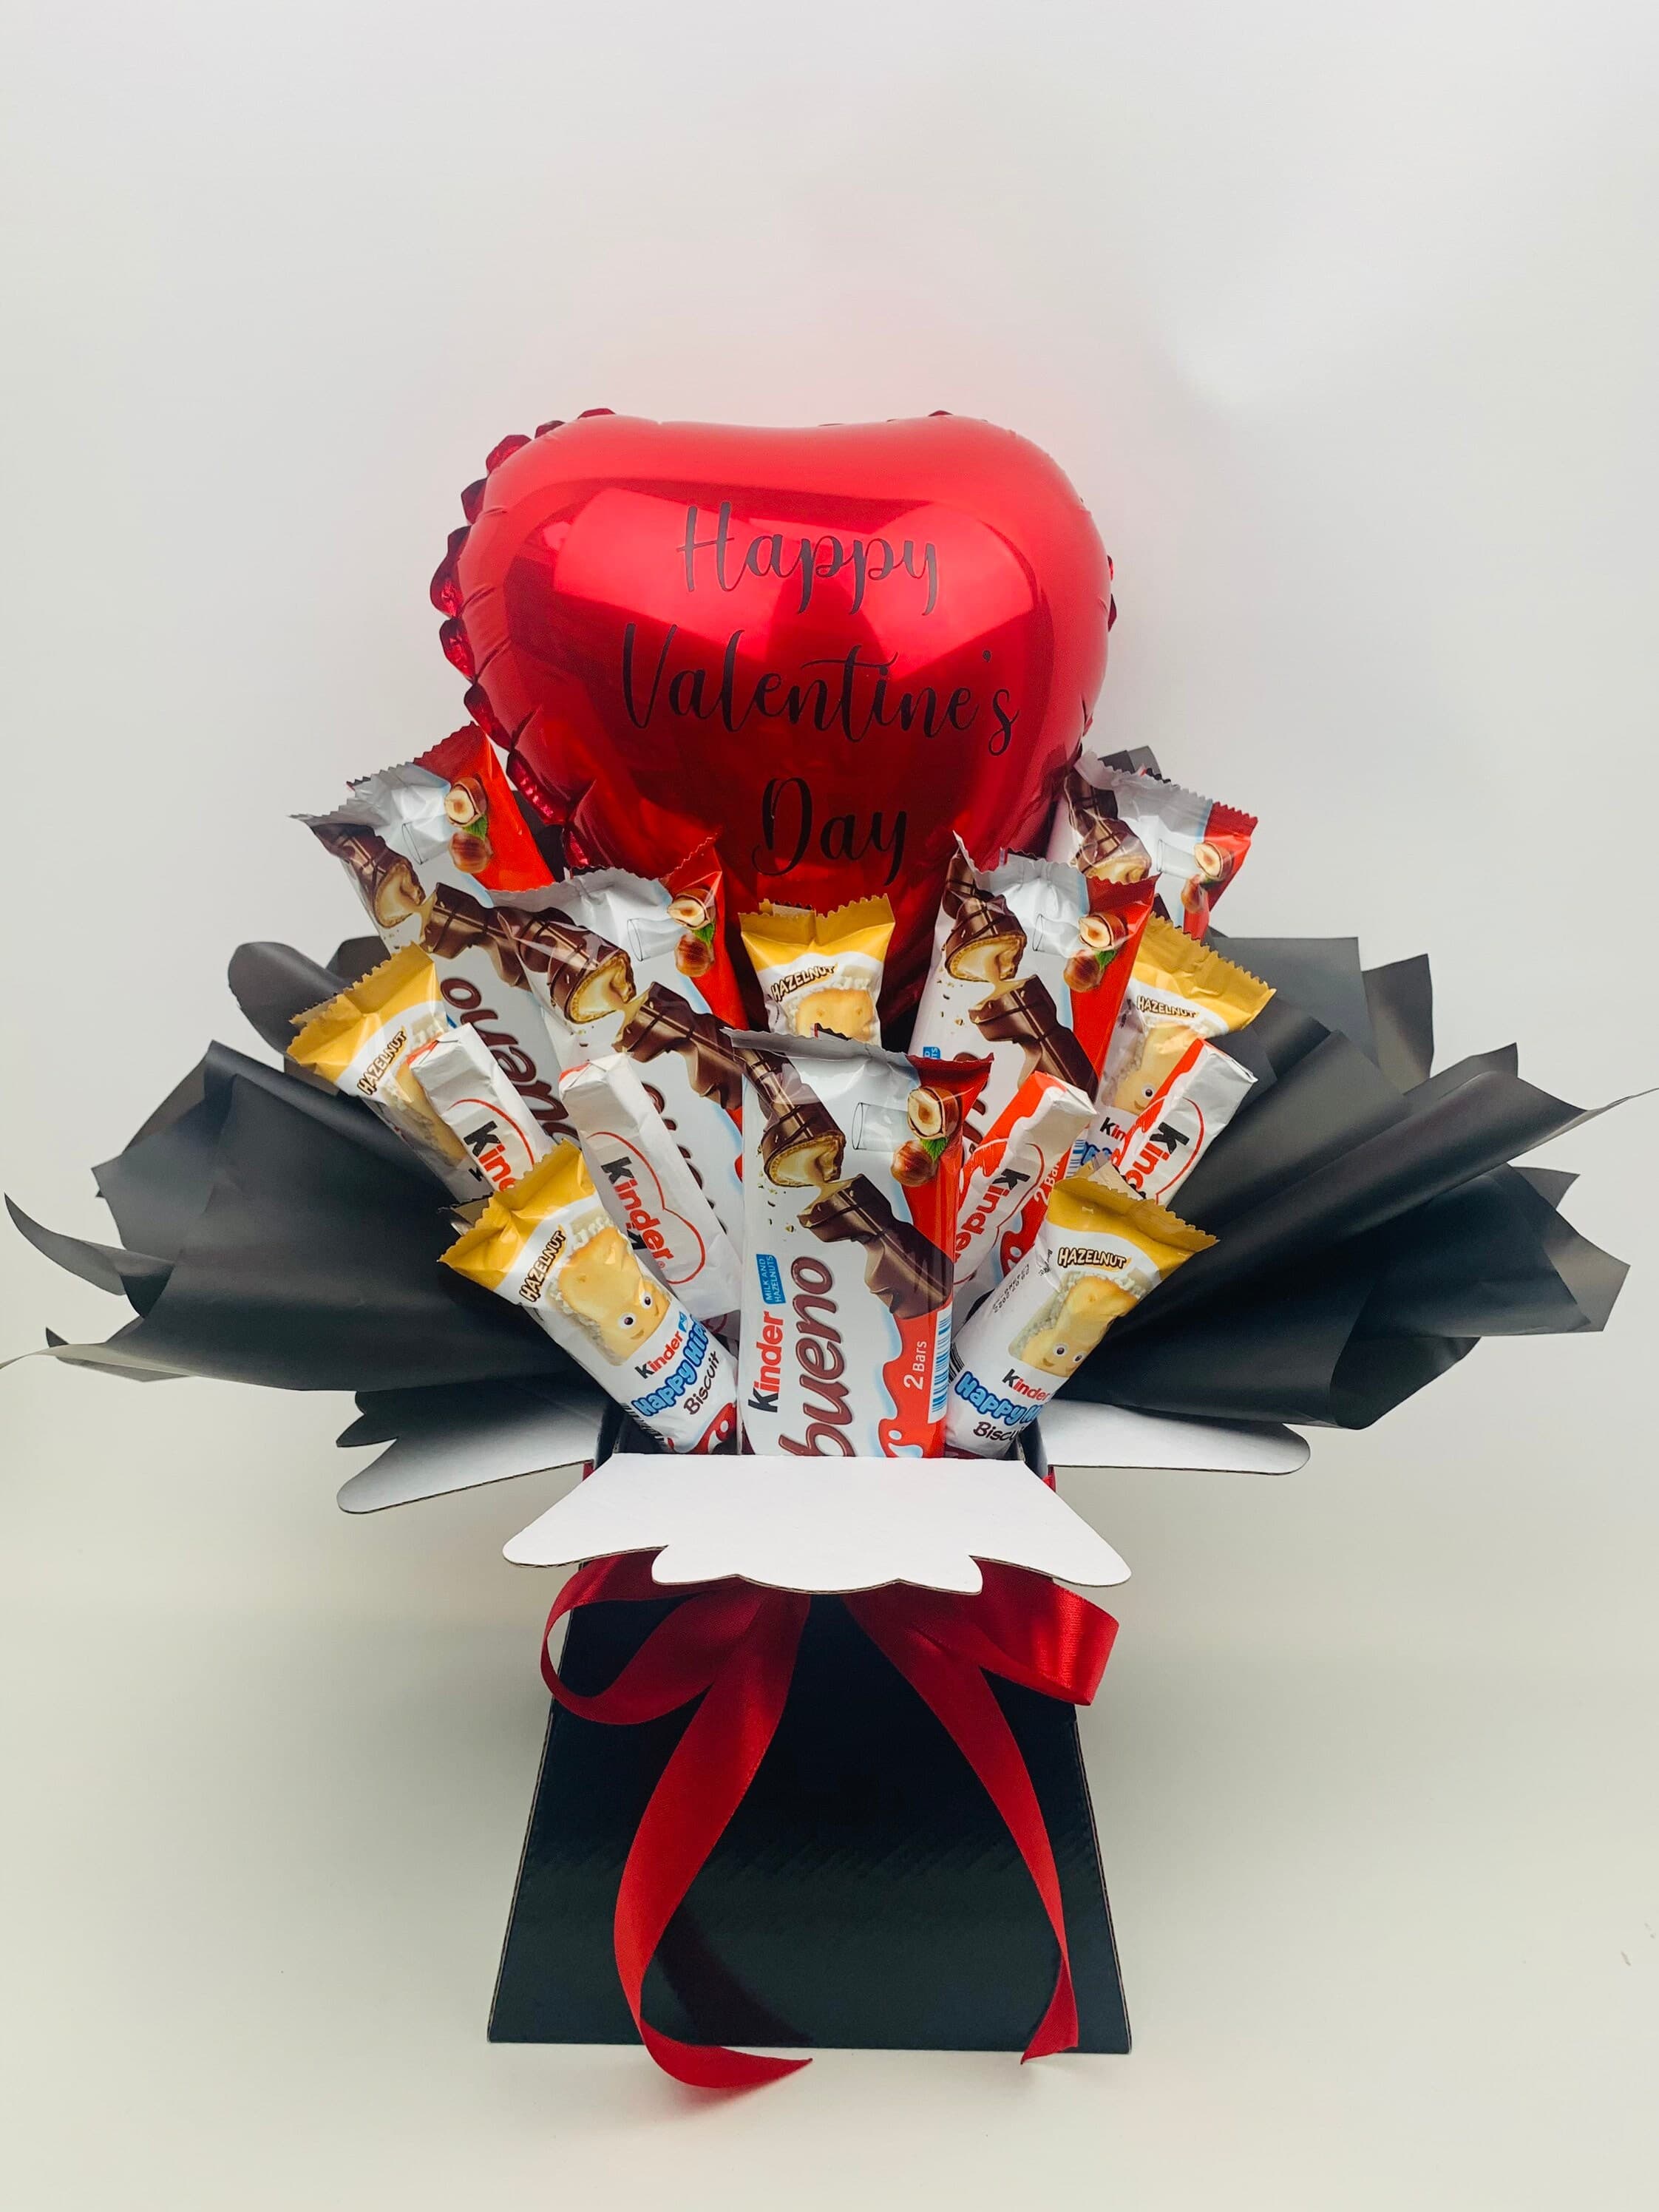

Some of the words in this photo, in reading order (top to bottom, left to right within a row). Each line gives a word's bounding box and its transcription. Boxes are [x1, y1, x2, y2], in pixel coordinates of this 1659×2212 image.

[676, 501, 937, 616] Happy
[622, 622, 1020, 756] Valentine's
[750, 777, 907, 886] Day
[770, 965, 836, 1002] HAZELNUT
[1136, 995, 1196, 1017] HAZELNUT
[356, 1028, 407, 1095] HAZELNUT
[600, 1156, 674, 1263] Kinder
[519, 1229, 567, 1303] HAZELNUT
[759, 1258, 767, 1278] AND
[763, 1280, 773, 1300] MILK
[767, 1255, 782, 1302] HAZELNUTS
[1057, 1247, 1127, 1269] HAZELNUT
[634, 1331, 684, 1379] Kinder
[683, 1351, 719, 1415] Biscuit
[747, 1311, 784, 1413] Kinder
[778, 1257, 856, 1456] bueno
[903, 1374, 924, 1390] 2
[914, 1340, 927, 1372] Bars
